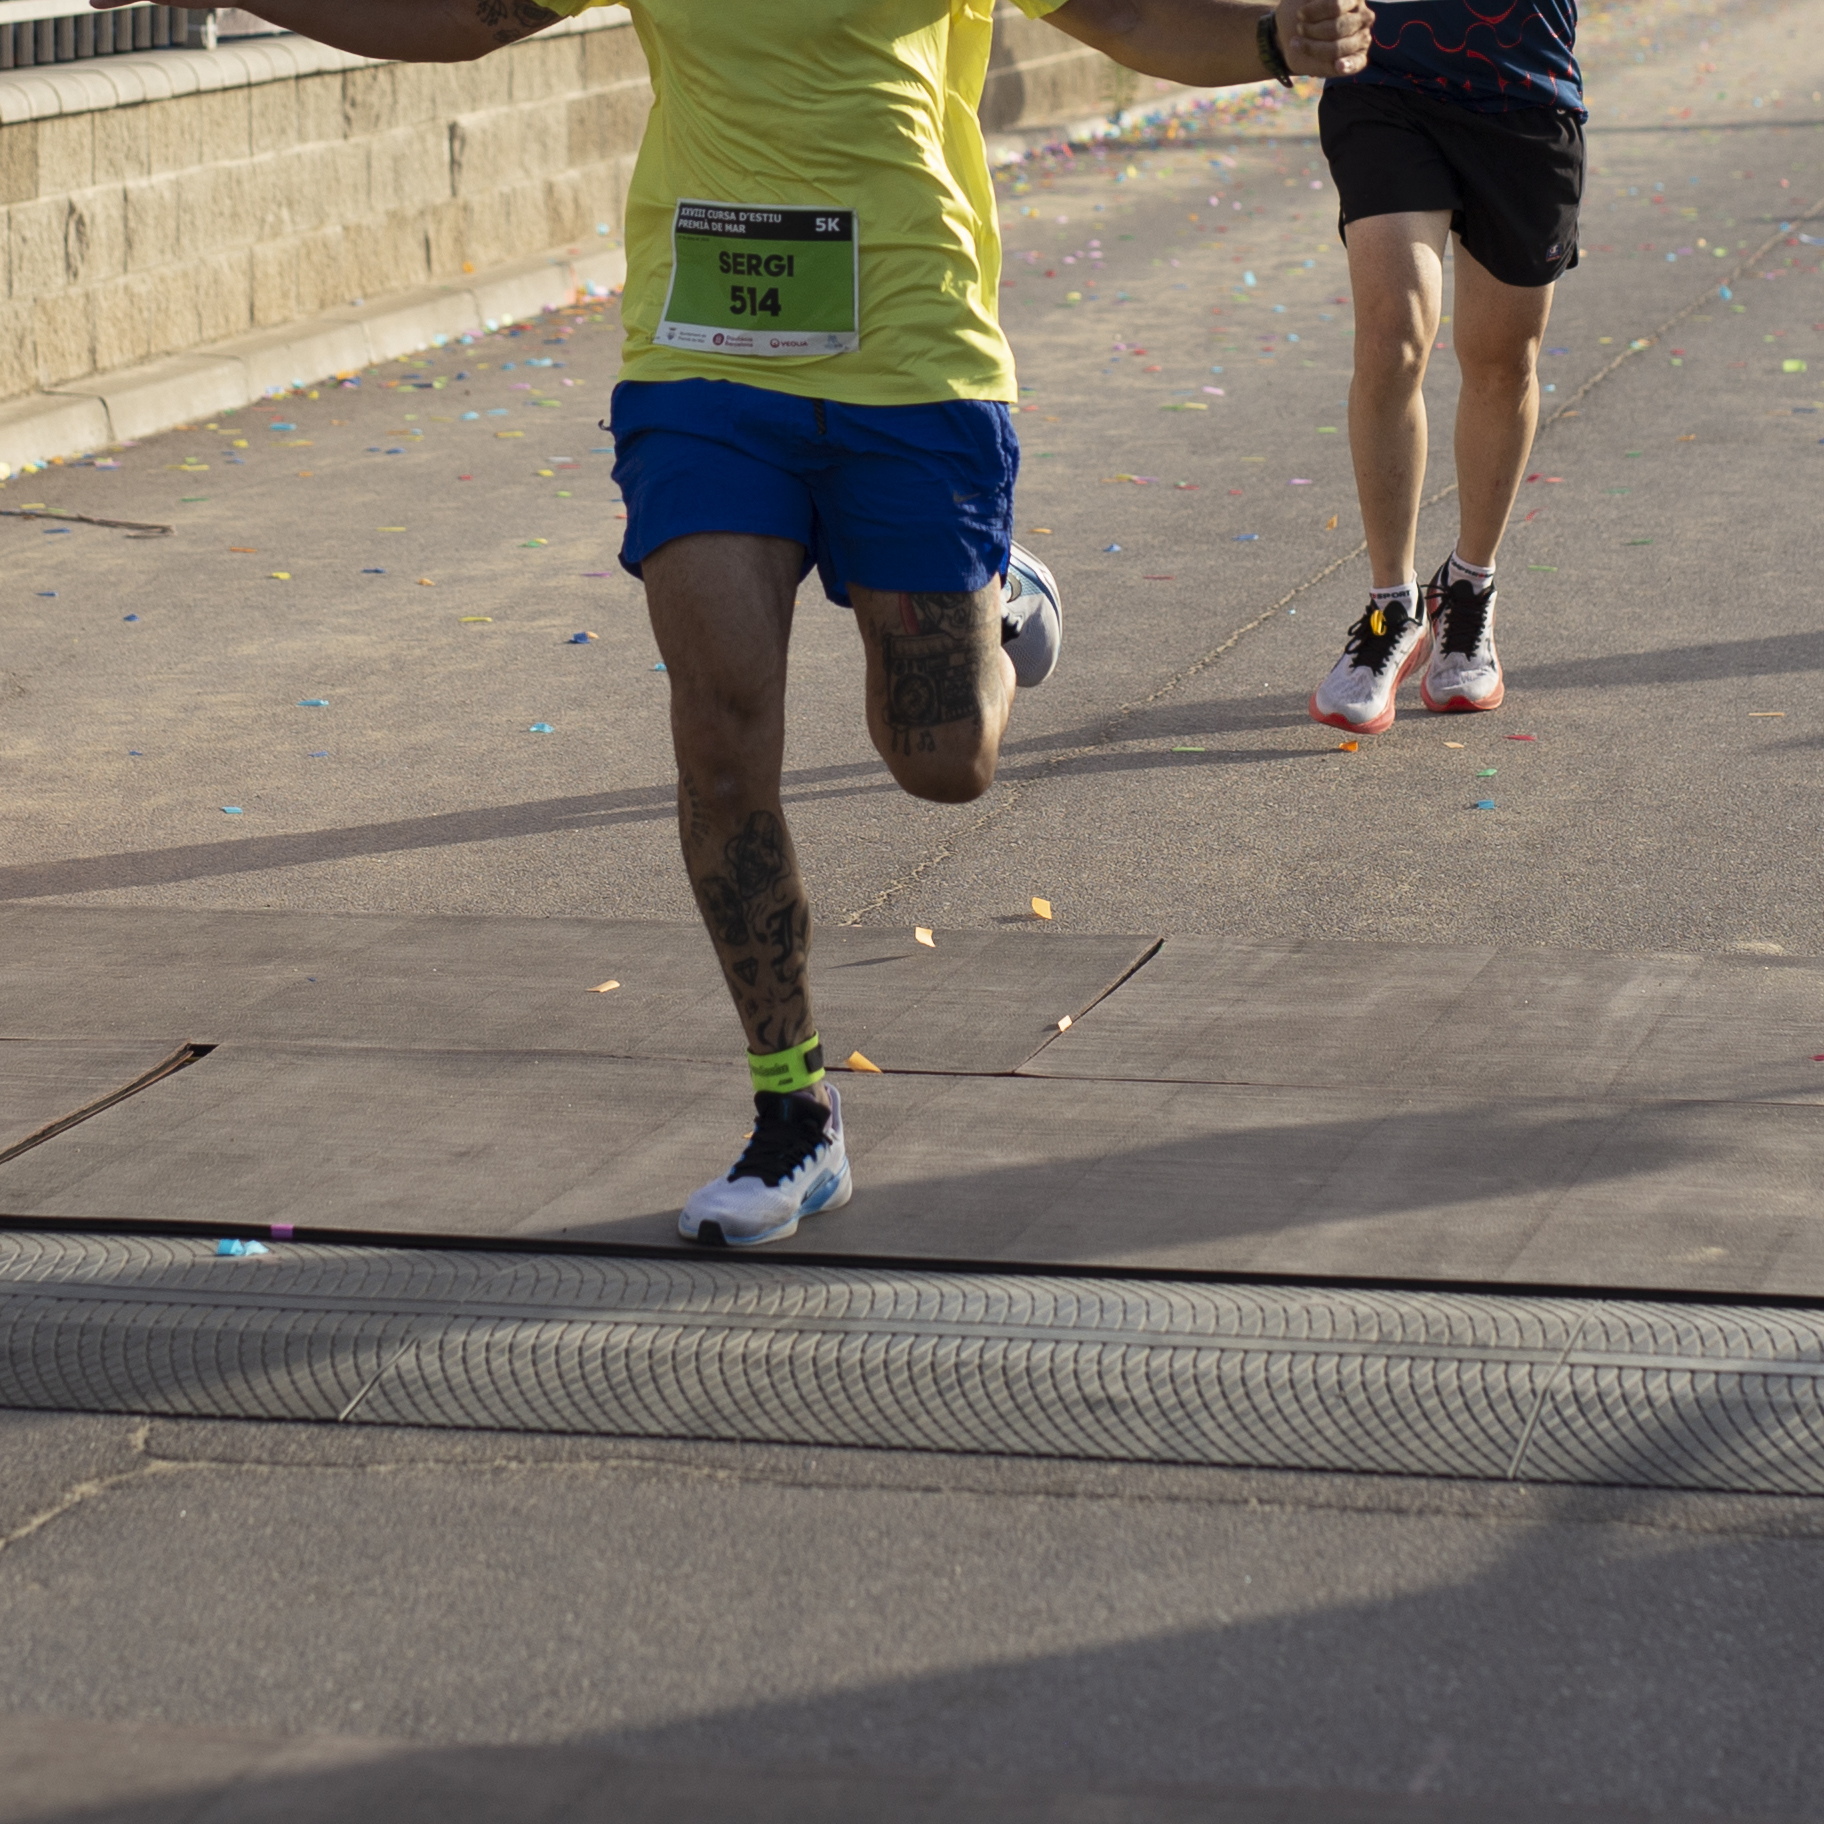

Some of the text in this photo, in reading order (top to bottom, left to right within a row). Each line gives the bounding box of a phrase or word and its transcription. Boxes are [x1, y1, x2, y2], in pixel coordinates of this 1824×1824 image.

[707, 209, 736, 222] CURSA
[739, 212, 782, 223] D'ESTIU
[815, 217, 840, 232] 5K
[711, 222, 723, 232] DE
[724, 223, 747, 233] MAR
[719, 250, 794, 277] SERGI
[729, 285, 782, 317] 514
